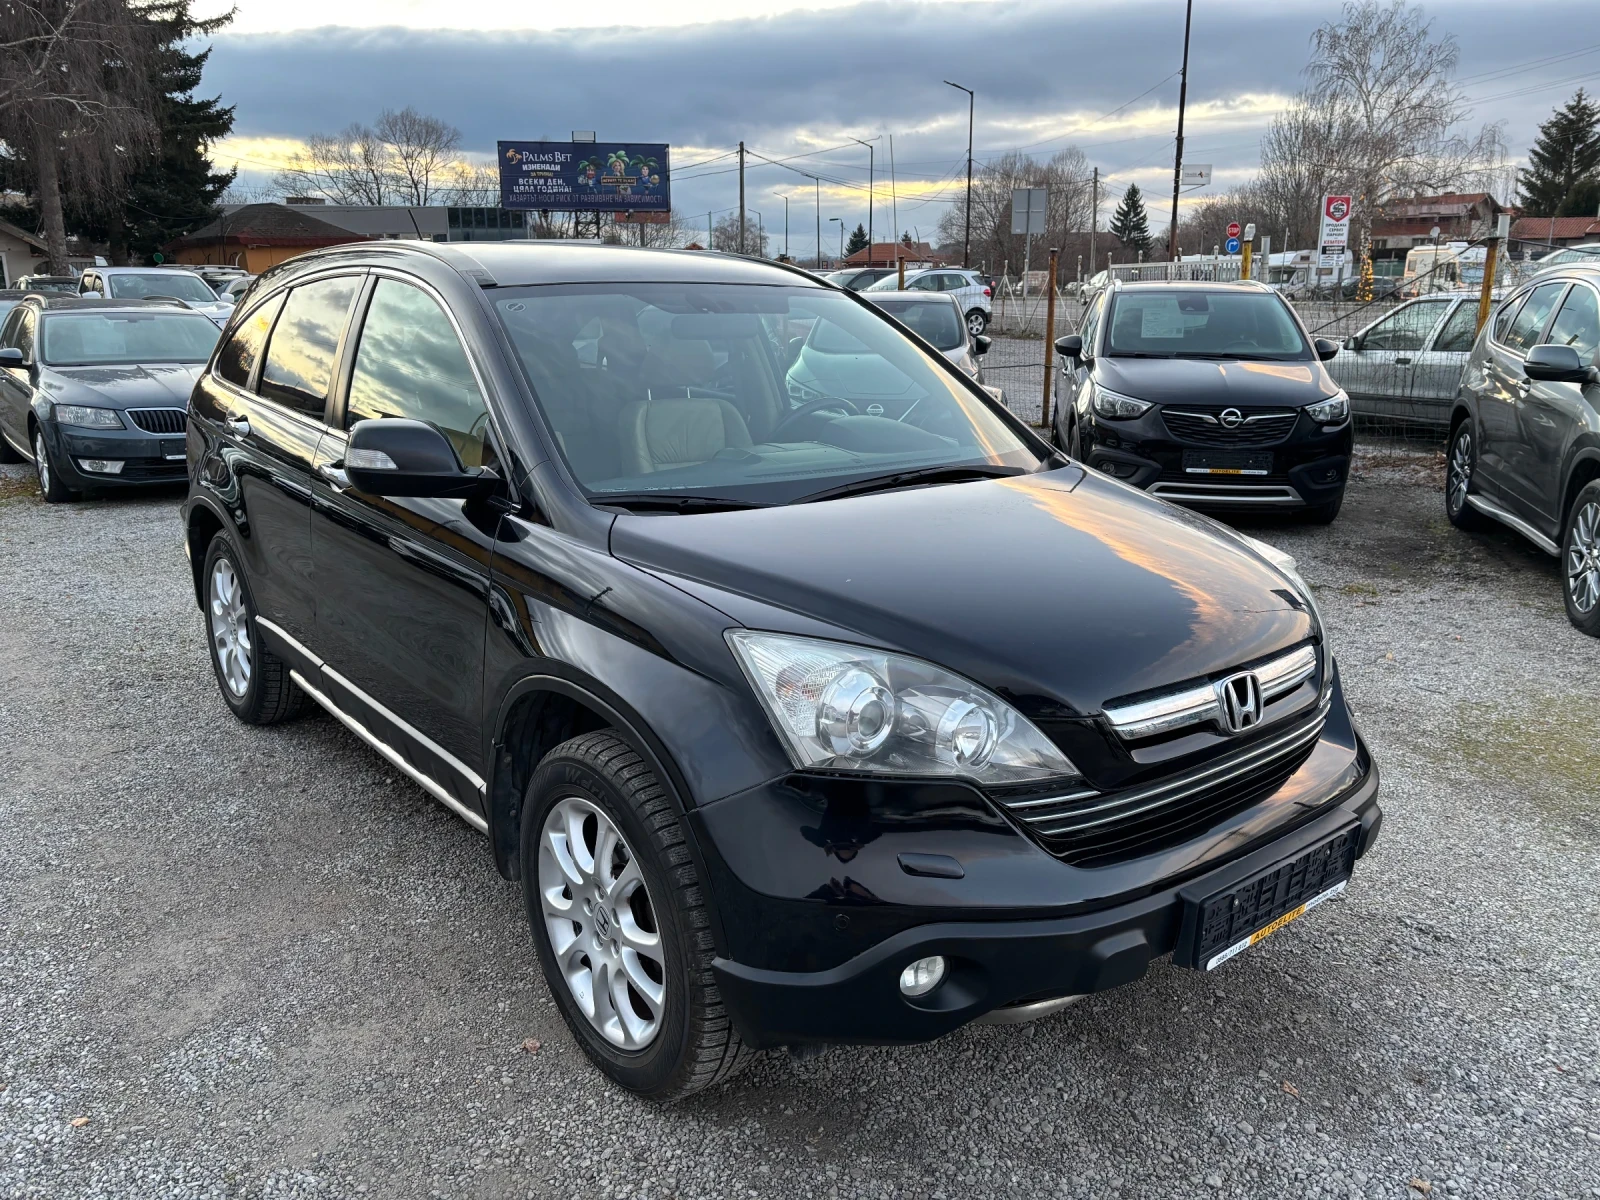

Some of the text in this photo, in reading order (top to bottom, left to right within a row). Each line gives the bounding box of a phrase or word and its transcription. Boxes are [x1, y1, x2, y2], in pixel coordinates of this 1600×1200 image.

[522, 151, 572, 162] PALMS BET
[522, 163, 560, 171] ИЗНЕНАДИ
[513, 185, 572, 193] ЦЯЛА ГОДИНА!
[509, 194, 537, 203] ХАЗАРТЪТ
[539, 194, 555, 203] НОСИ
[556, 194, 571, 203] РИСК
[572, 194, 579, 203] ОТ
[580, 194, 613, 203] РАЗВИВАНЕ
[614, 194, 623, 203] НА
[1253, 906, 1303, 942] AUTOELITE
